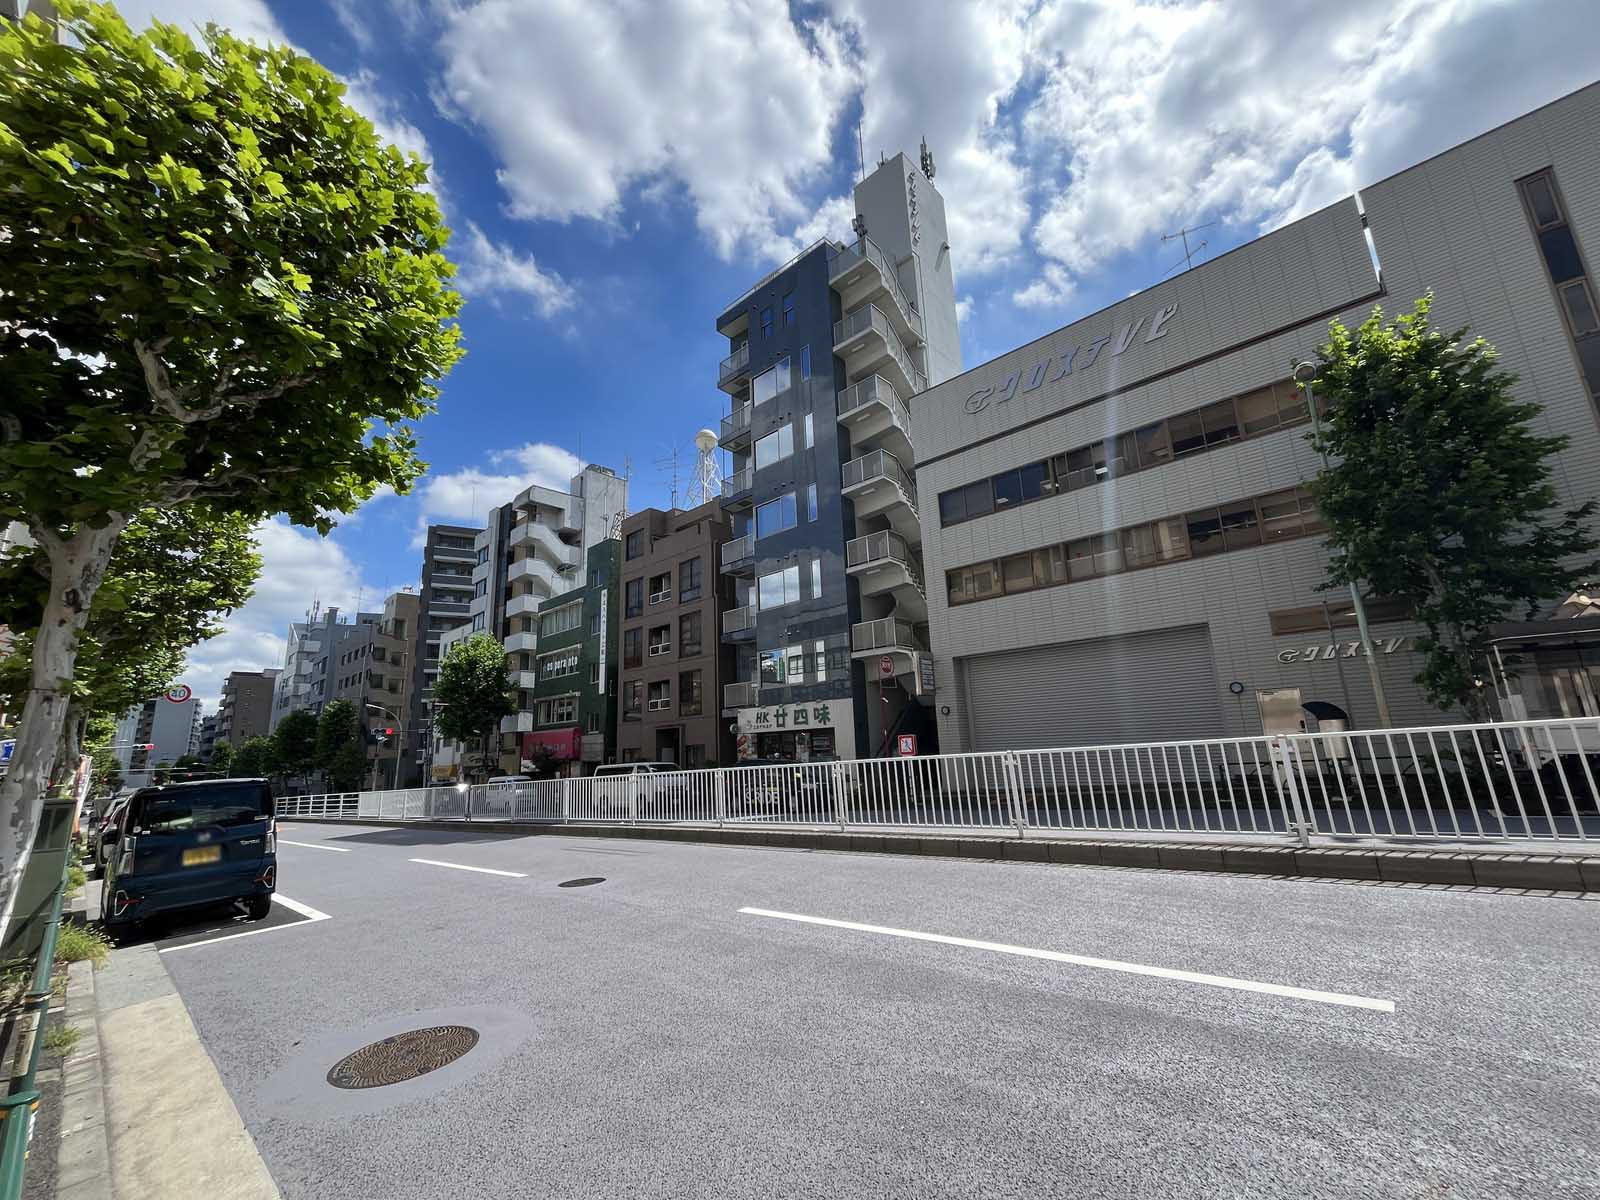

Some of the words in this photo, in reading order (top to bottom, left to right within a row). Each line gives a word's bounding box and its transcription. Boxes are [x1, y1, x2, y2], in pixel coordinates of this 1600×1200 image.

[171, 689, 186, 698] 40
[756, 711, 769, 724] HK
[774, 704, 831, 728] 廿四味
